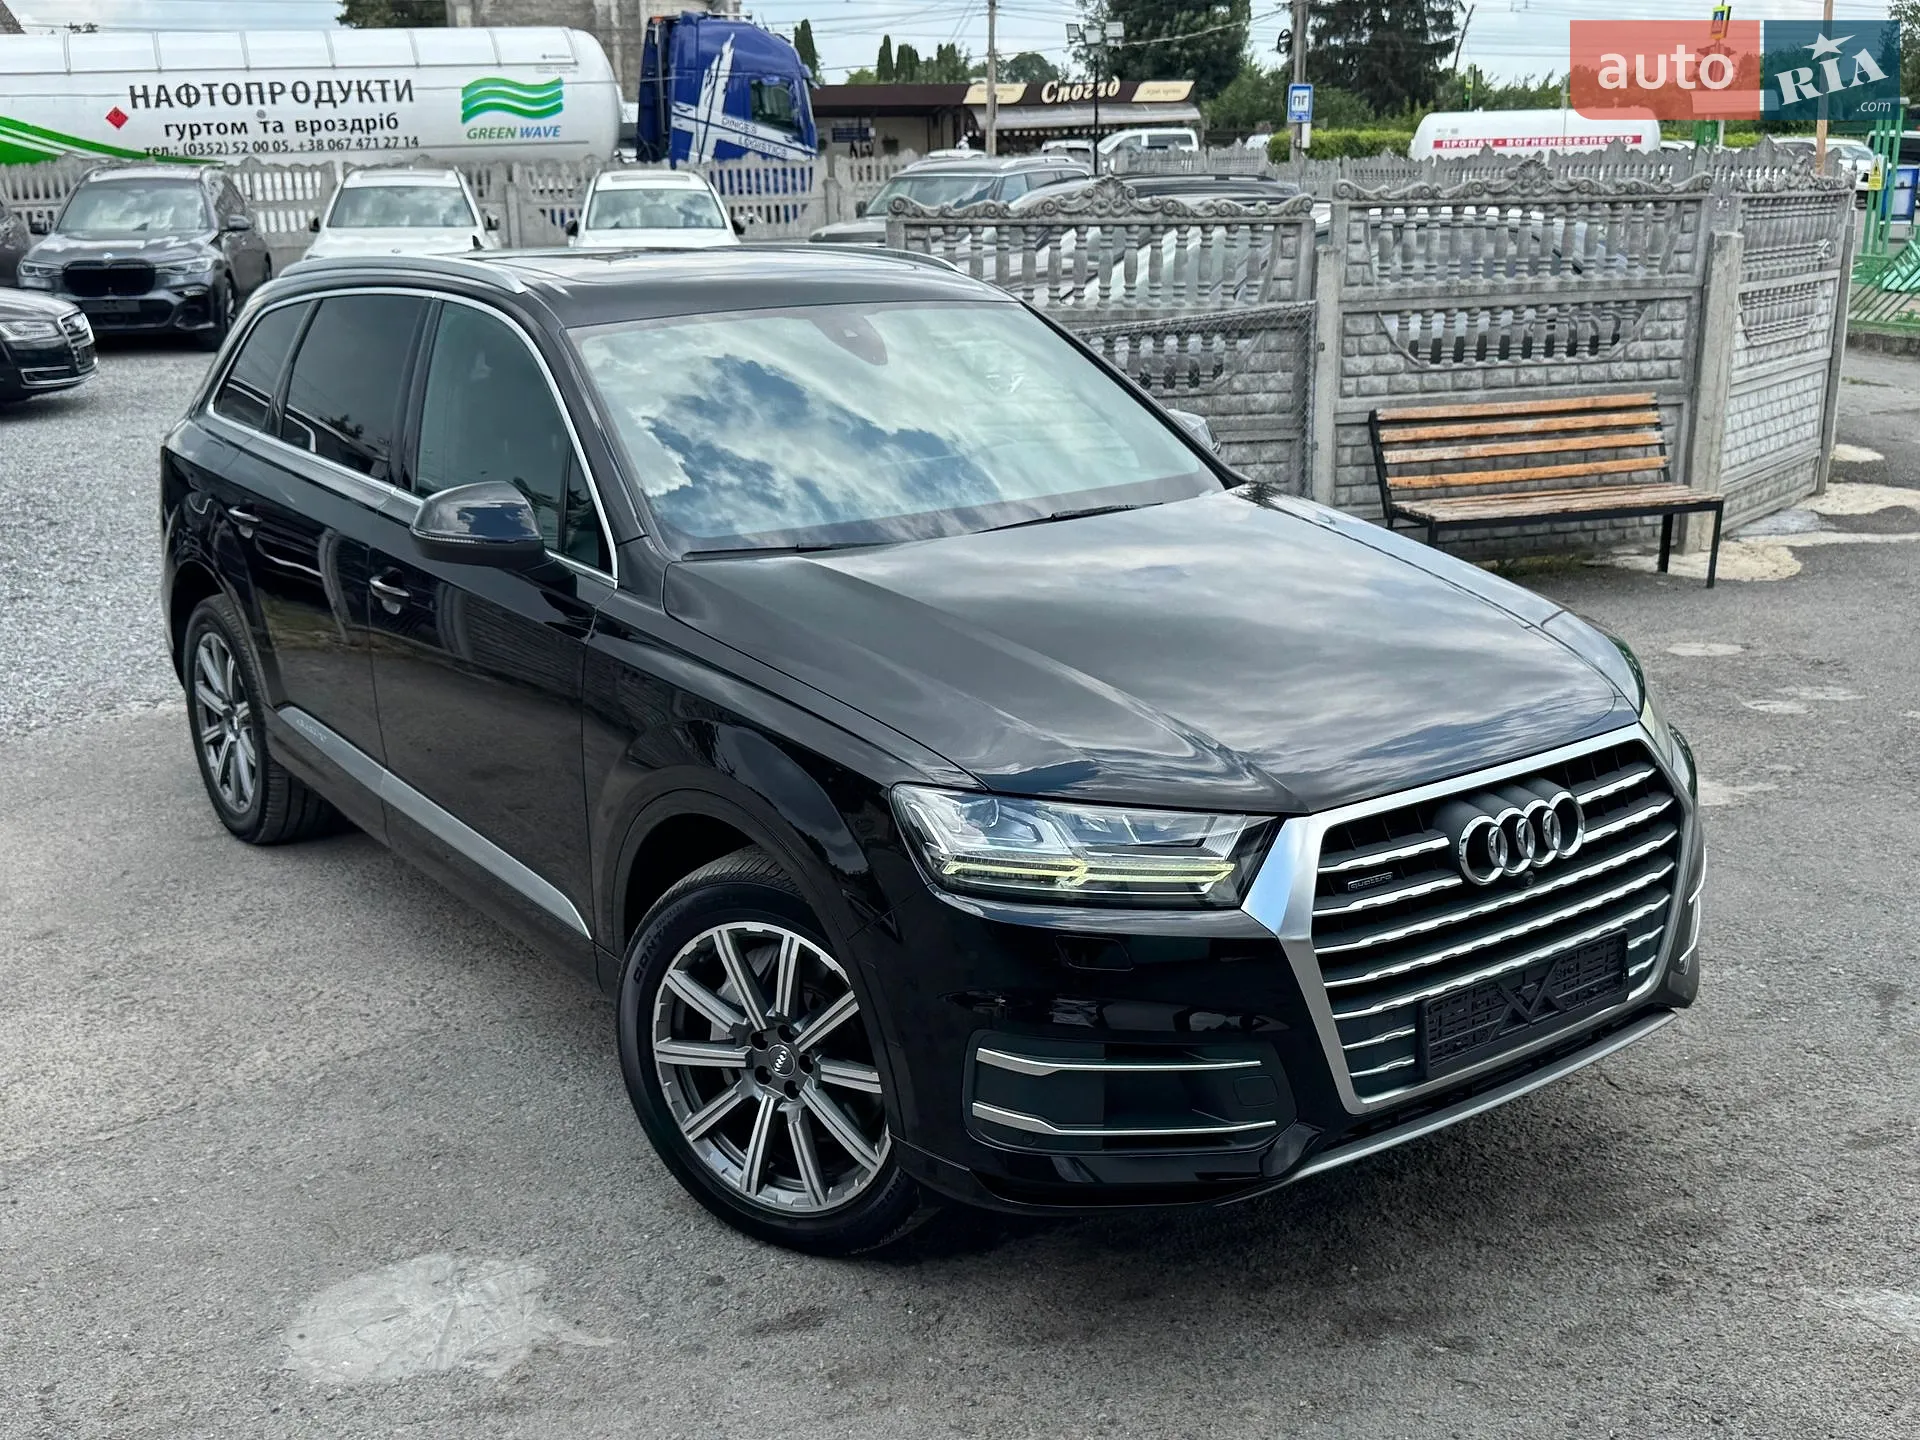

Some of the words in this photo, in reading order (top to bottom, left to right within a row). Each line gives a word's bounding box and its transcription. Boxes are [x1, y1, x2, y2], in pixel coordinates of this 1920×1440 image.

[129, 79, 414, 109] НАФТОПРОДУКТИ
[164, 121, 248, 141] гуртом
[259, 120, 284, 134] та
[295, 112, 399, 136] вроздріб
[466, 127, 516, 140] GREEN
[519, 125, 561, 139] WAVE
[183, 141, 229, 157] (0352)
[233, 141, 248, 154] 52
[252, 140, 269, 153] 00
[298, 138, 324, 152] +38
[327, 138, 351, 151] 067
[356, 137, 378, 150] 471
[384, 136, 399, 149] 27
[404, 136, 419, 149] 14
[1350, 874, 1392, 889] quattro
